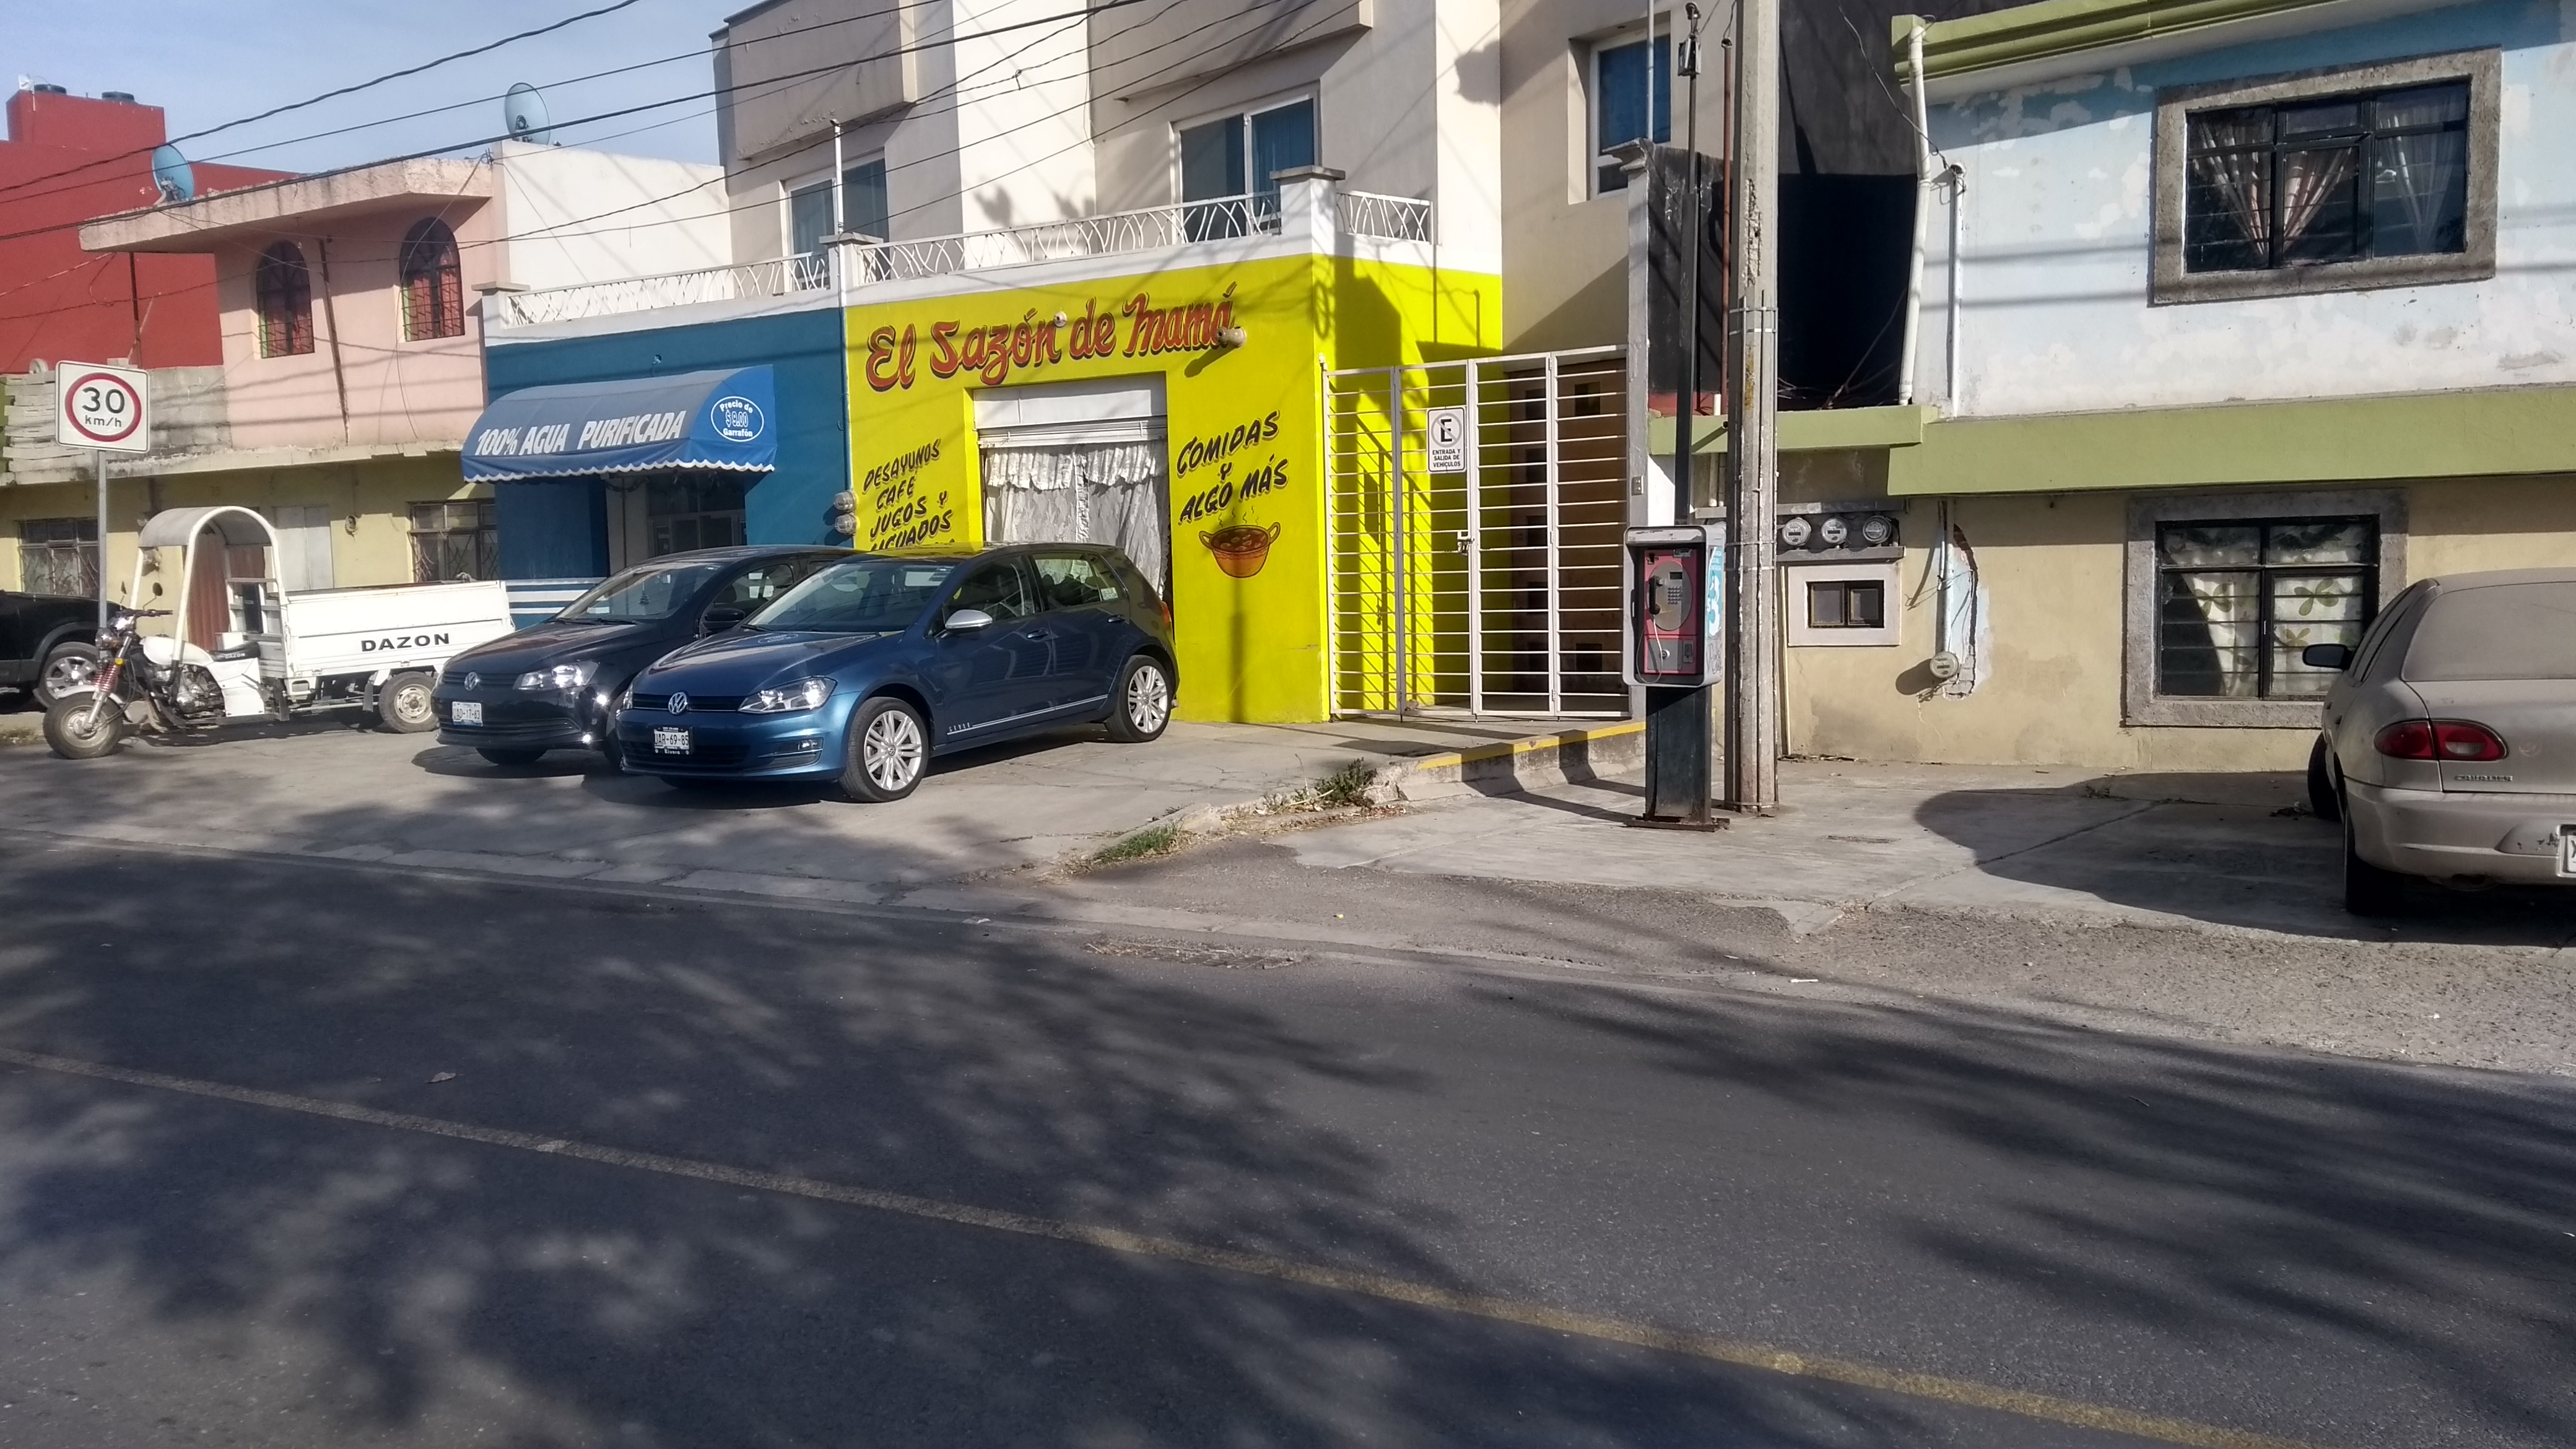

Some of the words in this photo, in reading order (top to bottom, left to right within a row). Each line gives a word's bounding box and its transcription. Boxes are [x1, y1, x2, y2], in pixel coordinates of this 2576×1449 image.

[866, 323, 916, 392] El
[930, 308, 1061, 385] Sazón
[1069, 297, 1116, 359] de
[82, 386, 125, 414] 30
[720, 399, 742, 412] Precio
[85, 415, 121, 427] km/h
[475, 427, 522, 456] 100%
[519, 424, 570, 456] AGUA
[577, 411, 687, 450] PURIFICADA
[723, 428, 753, 437] Garrafón
[1440, 419, 1452, 442] E
[1177, 410, 1280, 478] COMIDAS
[862, 438, 941, 495] DESAYUNOS
[1218, 462, 1232, 483] Y
[1178, 482, 1232, 525] ALGO
[1239, 454, 1288, 502] MÁS
[870, 496, 927, 540] JUGOS
[938, 490, 948, 508] Y
[361, 633, 449, 651] DAZON
[949, 722, 970, 732] STYLE
